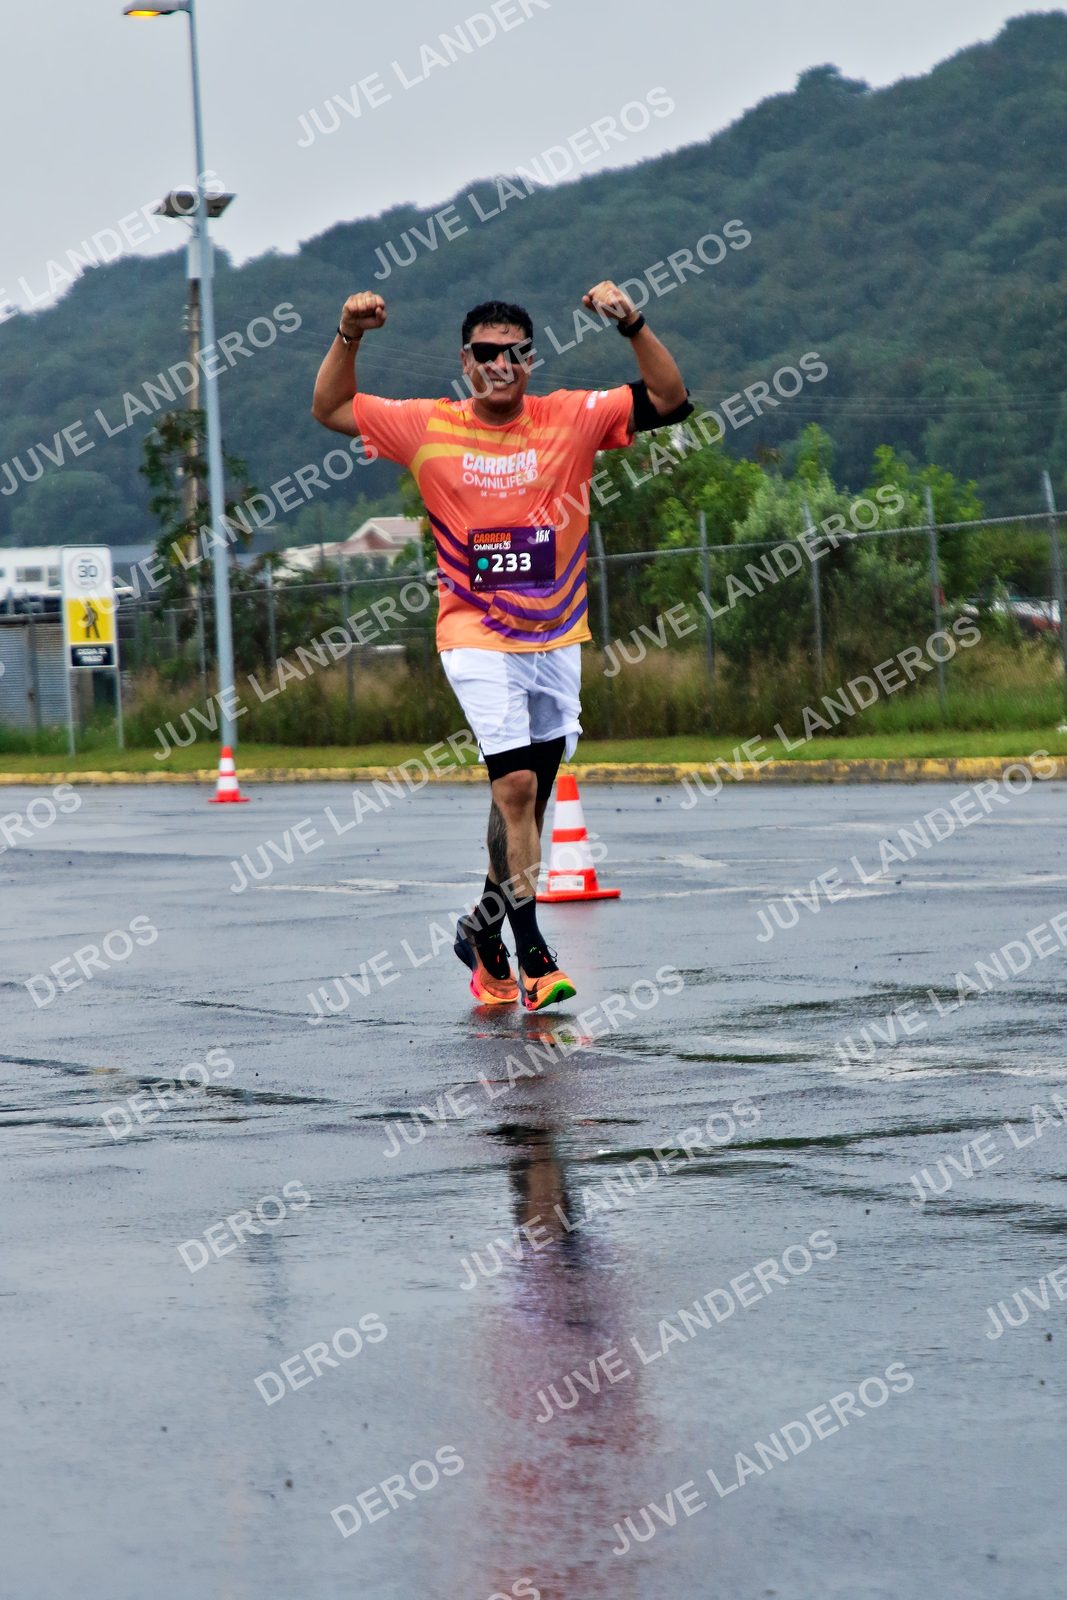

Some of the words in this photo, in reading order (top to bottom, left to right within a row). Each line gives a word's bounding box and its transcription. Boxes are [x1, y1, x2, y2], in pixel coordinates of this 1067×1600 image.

[463, 448, 537, 475] CARRERA
[463, 471, 525, 489] OMNILIFE
[473, 532, 512, 544] CARRERA
[473, 542, 503, 551] OMNILIFE
[491, 552, 532, 573] 233
[78, 565, 98, 578] 30
